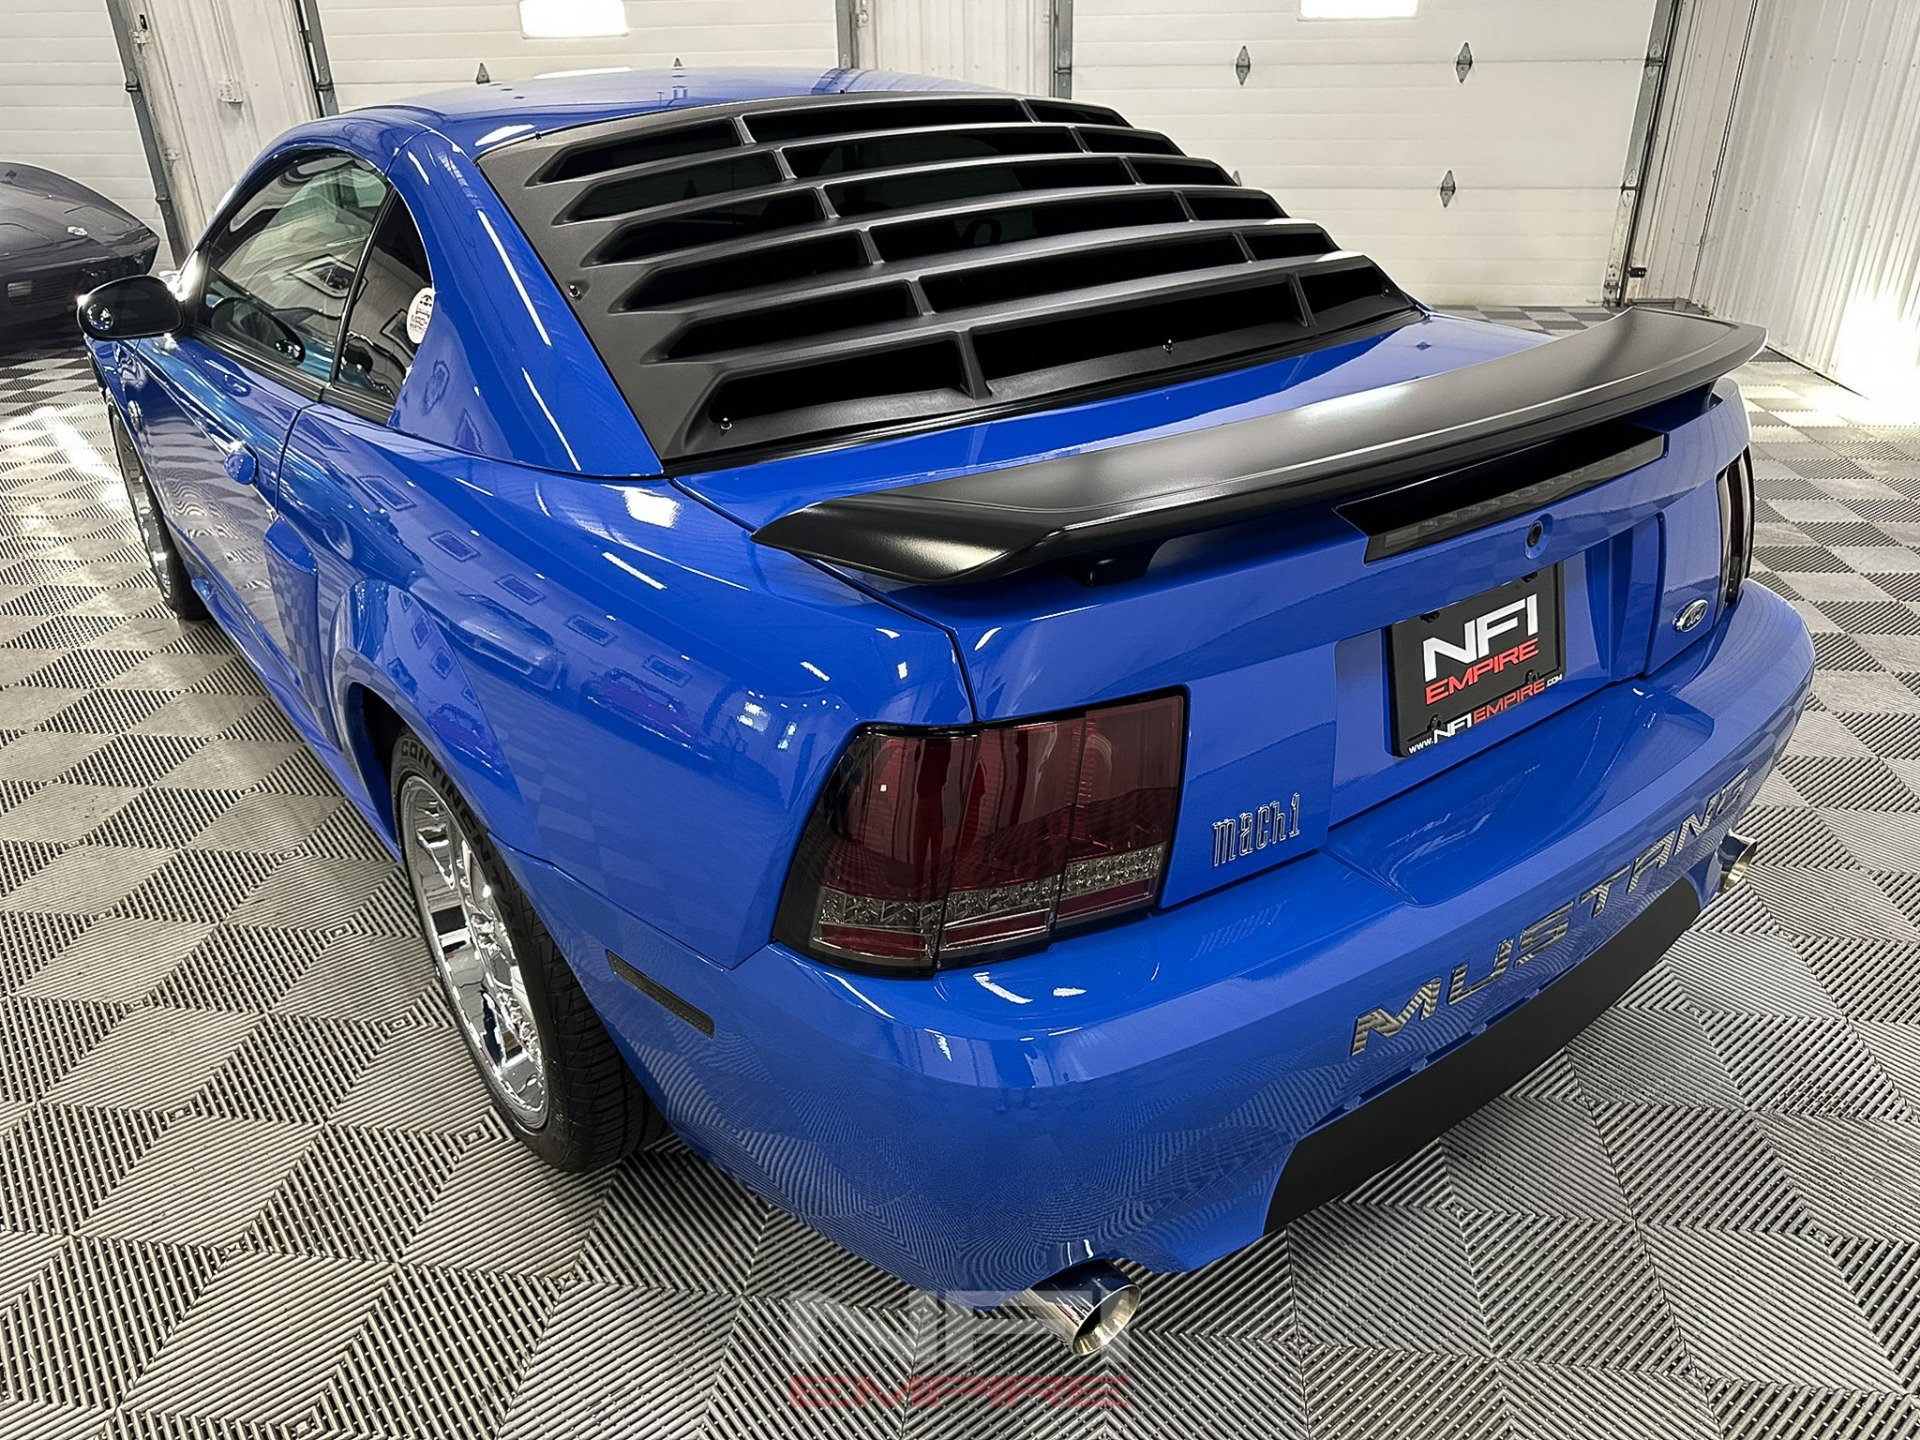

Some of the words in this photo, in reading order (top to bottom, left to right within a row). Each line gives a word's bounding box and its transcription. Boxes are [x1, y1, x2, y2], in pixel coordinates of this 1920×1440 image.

[1422, 593, 1538, 683] NFI
[1425, 637, 1539, 706] EMPIRE
[1349, 766, 1750, 1057] MUSTANG
